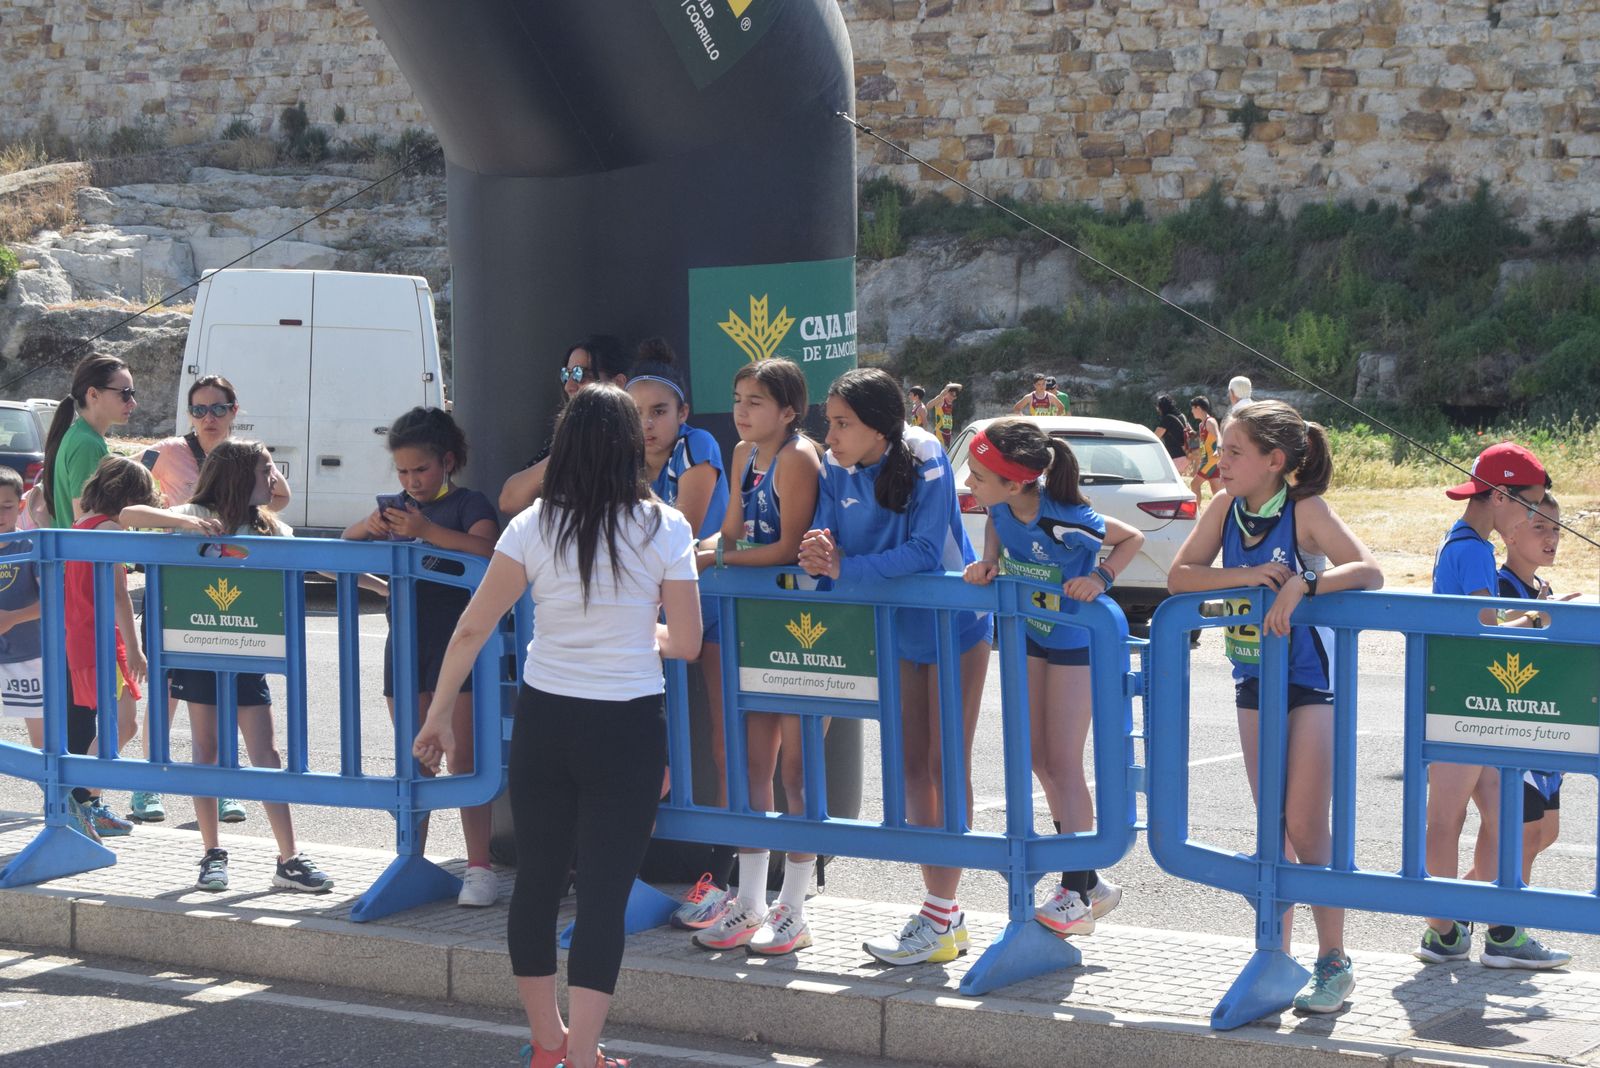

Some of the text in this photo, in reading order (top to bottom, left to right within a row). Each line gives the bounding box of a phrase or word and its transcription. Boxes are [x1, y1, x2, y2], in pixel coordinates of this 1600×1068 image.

[686, 4, 720, 61] CORRILLO
[800, 310, 857, 341] CAJA RU
[803, 346, 821, 362] DE
[1006, 561, 1051, 577] FUNDACION
[190, 613, 258, 628] CAJA RURAL
[183, 633, 266, 649] Compartimos futuro
[769, 651, 846, 668] CAJA RURAL
[762, 672, 856, 691] Compartimos futuro
[1465, 695, 1561, 716] CAJA RURAL
[1454, 720, 1571, 742] Compartimos futuro
